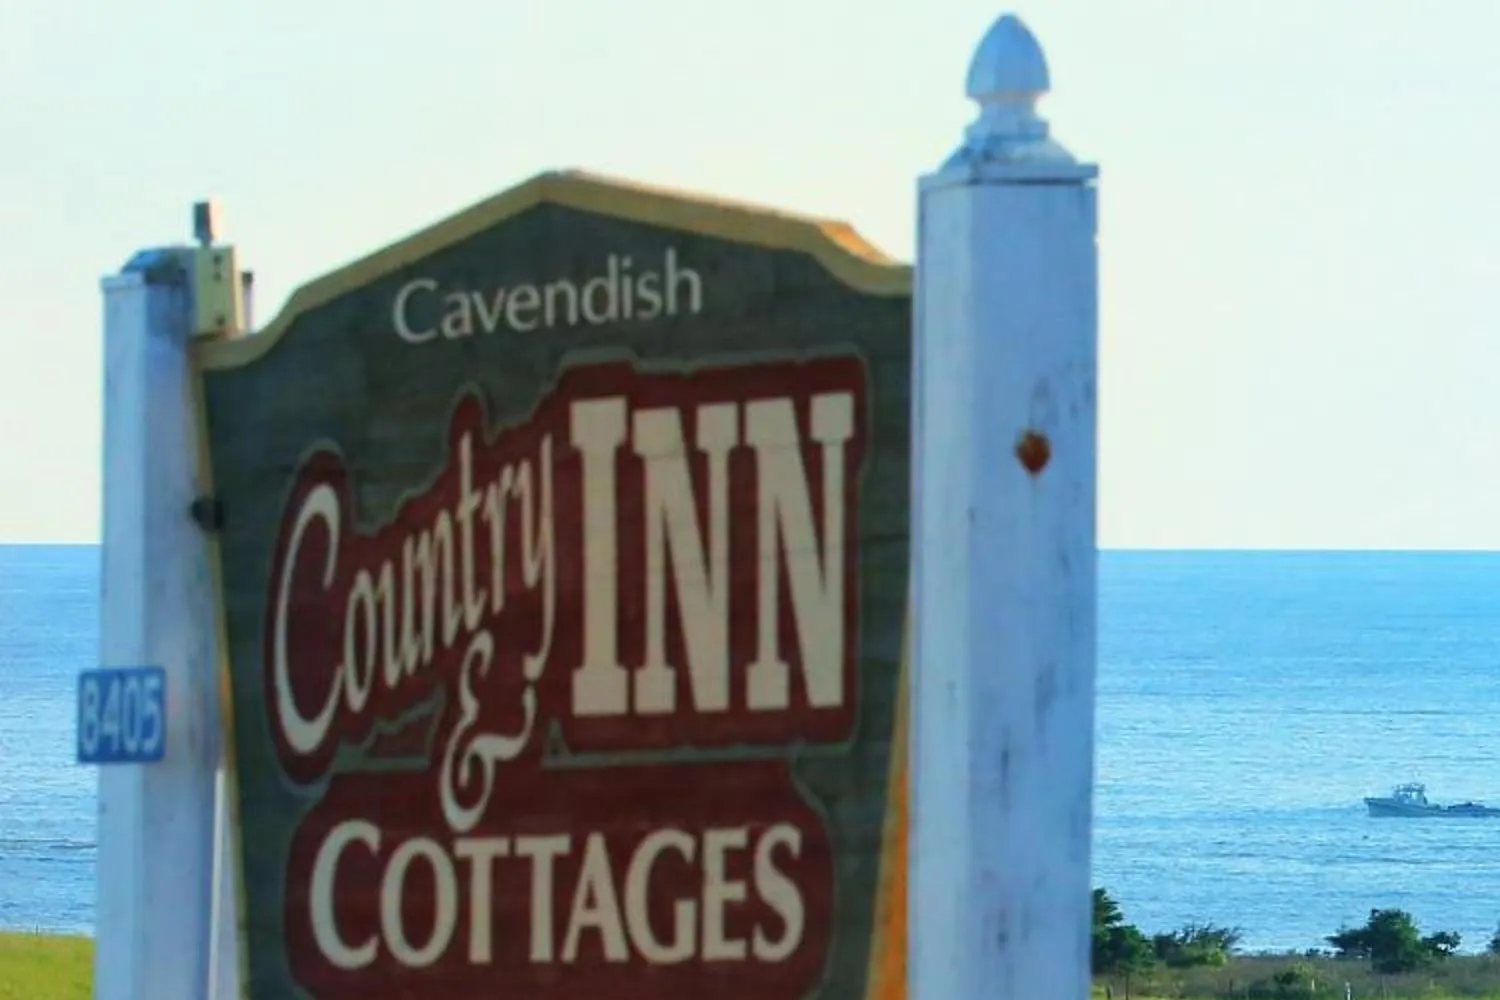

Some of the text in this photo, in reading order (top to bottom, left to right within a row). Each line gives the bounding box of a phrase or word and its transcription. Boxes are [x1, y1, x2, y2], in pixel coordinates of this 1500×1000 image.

[392, 247, 703, 343] Cavendish
[274, 391, 855, 754] Country INN
[81, 674, 162, 756] 8405
[309, 819, 804, 969] COTTAGES
